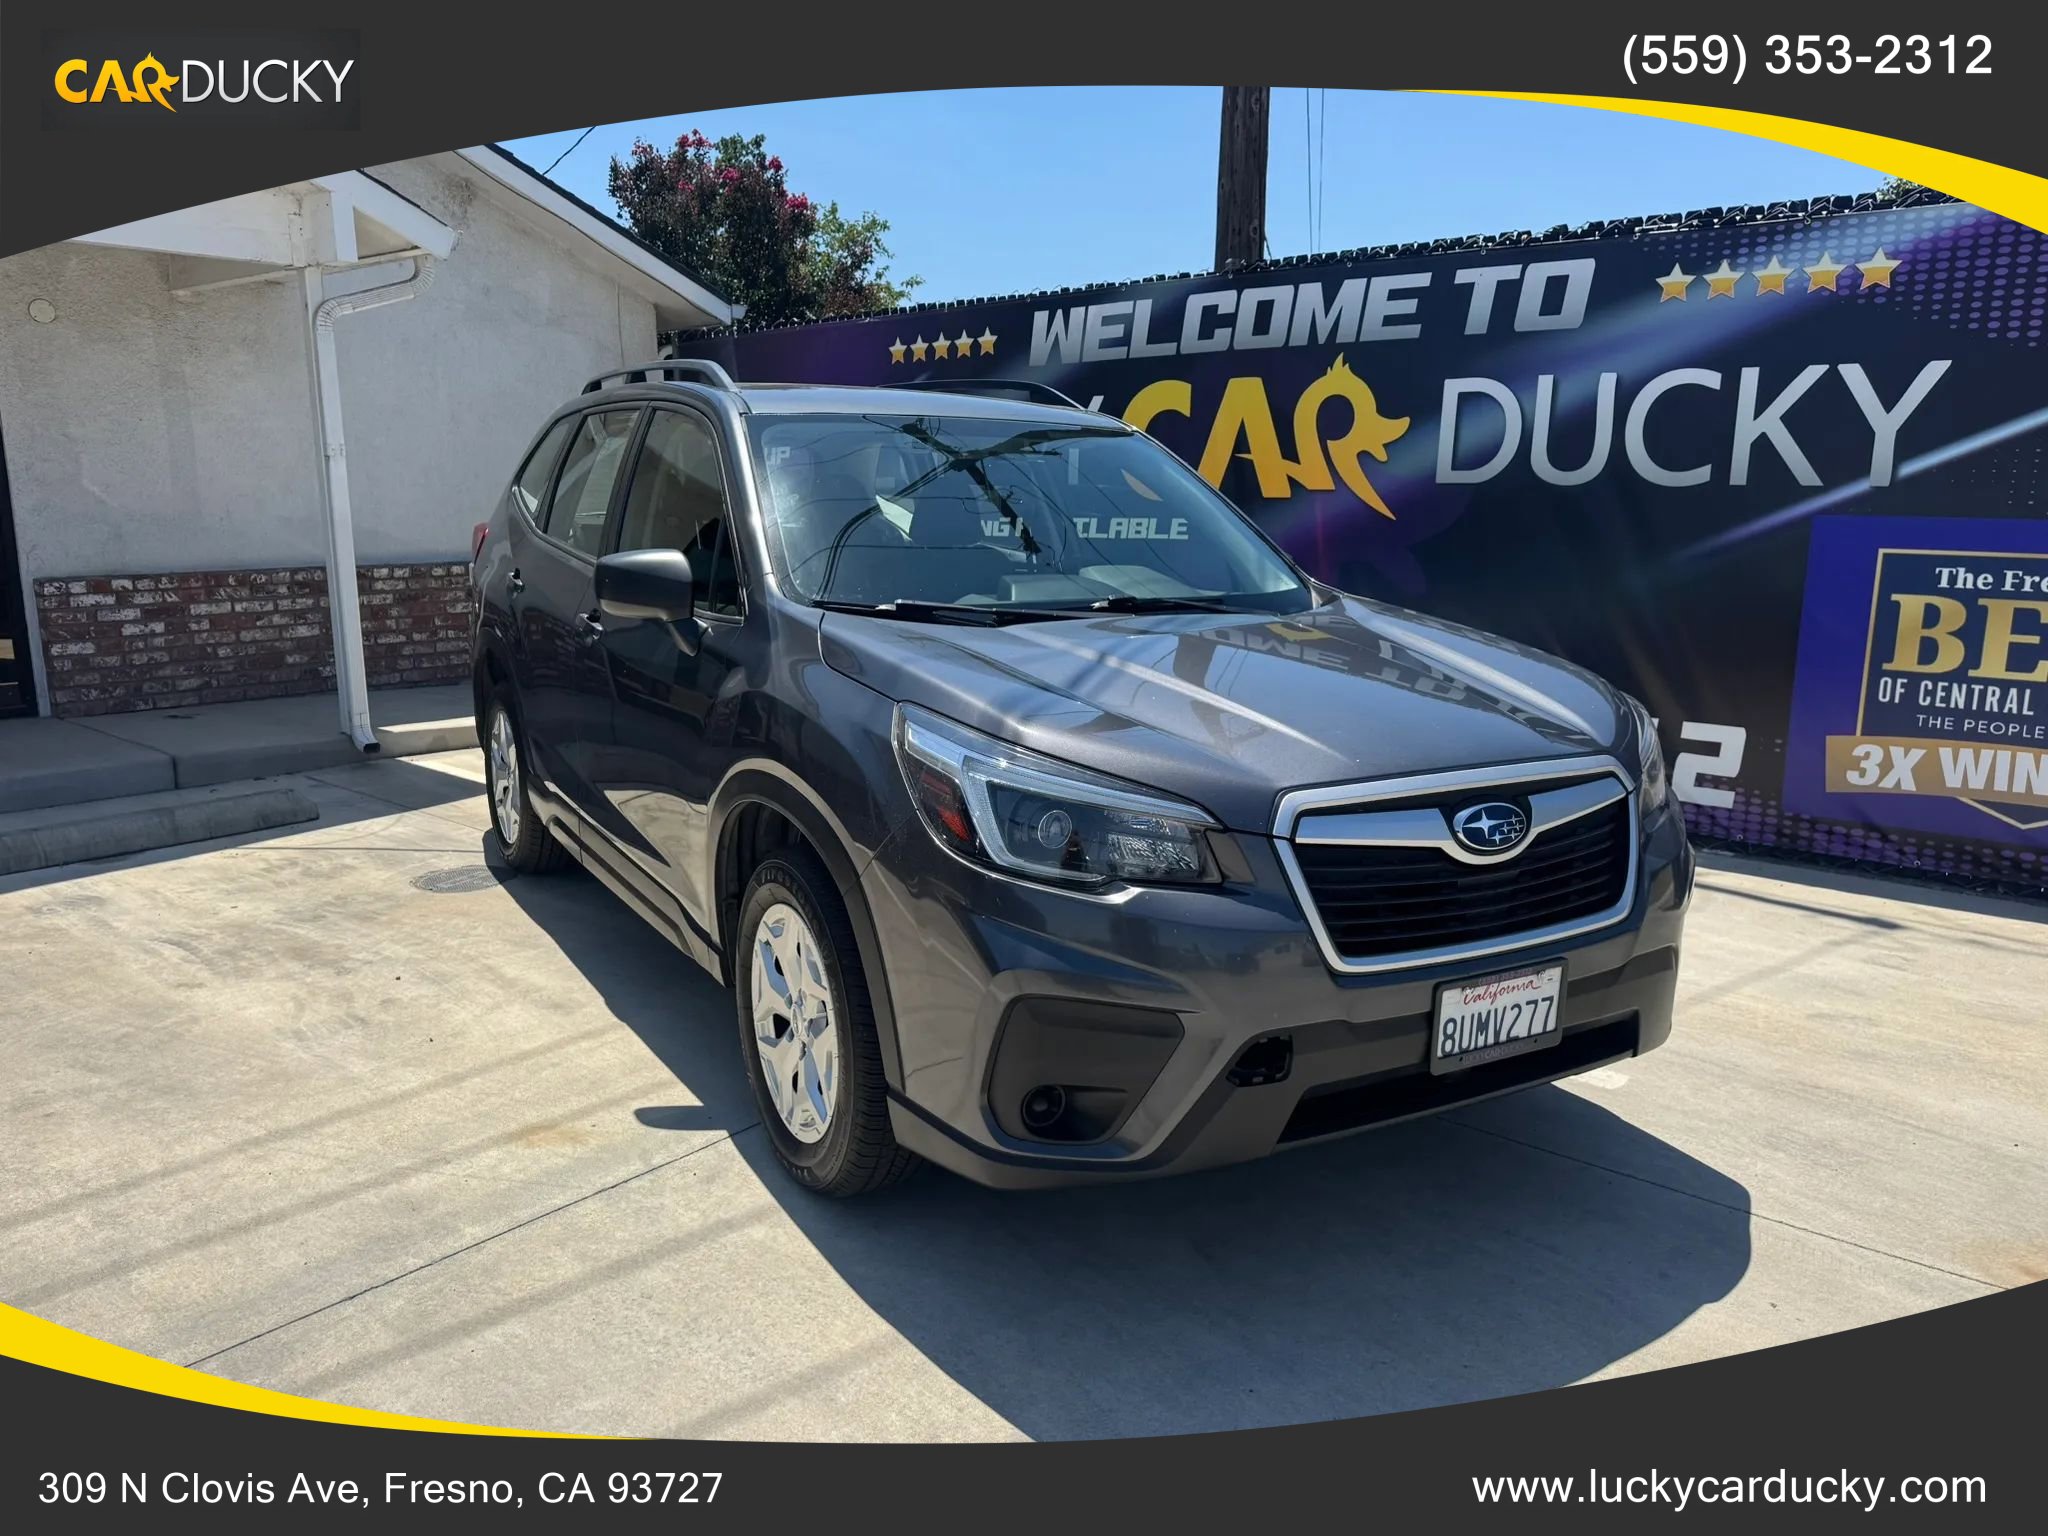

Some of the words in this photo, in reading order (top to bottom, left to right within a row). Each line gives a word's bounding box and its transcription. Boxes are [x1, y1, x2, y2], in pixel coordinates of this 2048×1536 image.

[1028, 271, 1432, 367] WELCOME
[1454, 258, 1596, 336] TO
[1435, 359, 1953, 488] DUCKY
[1935, 566, 1994, 590] The
[1878, 676, 1908, 703] OF
[1918, 679, 2035, 716] CENTRAL
[1916, 714, 1954, 730] THE
[1846, 744, 1928, 792] 3X
[1463, 976, 1542, 1006] California
[1440, 995, 1555, 1056] 8UMV277
